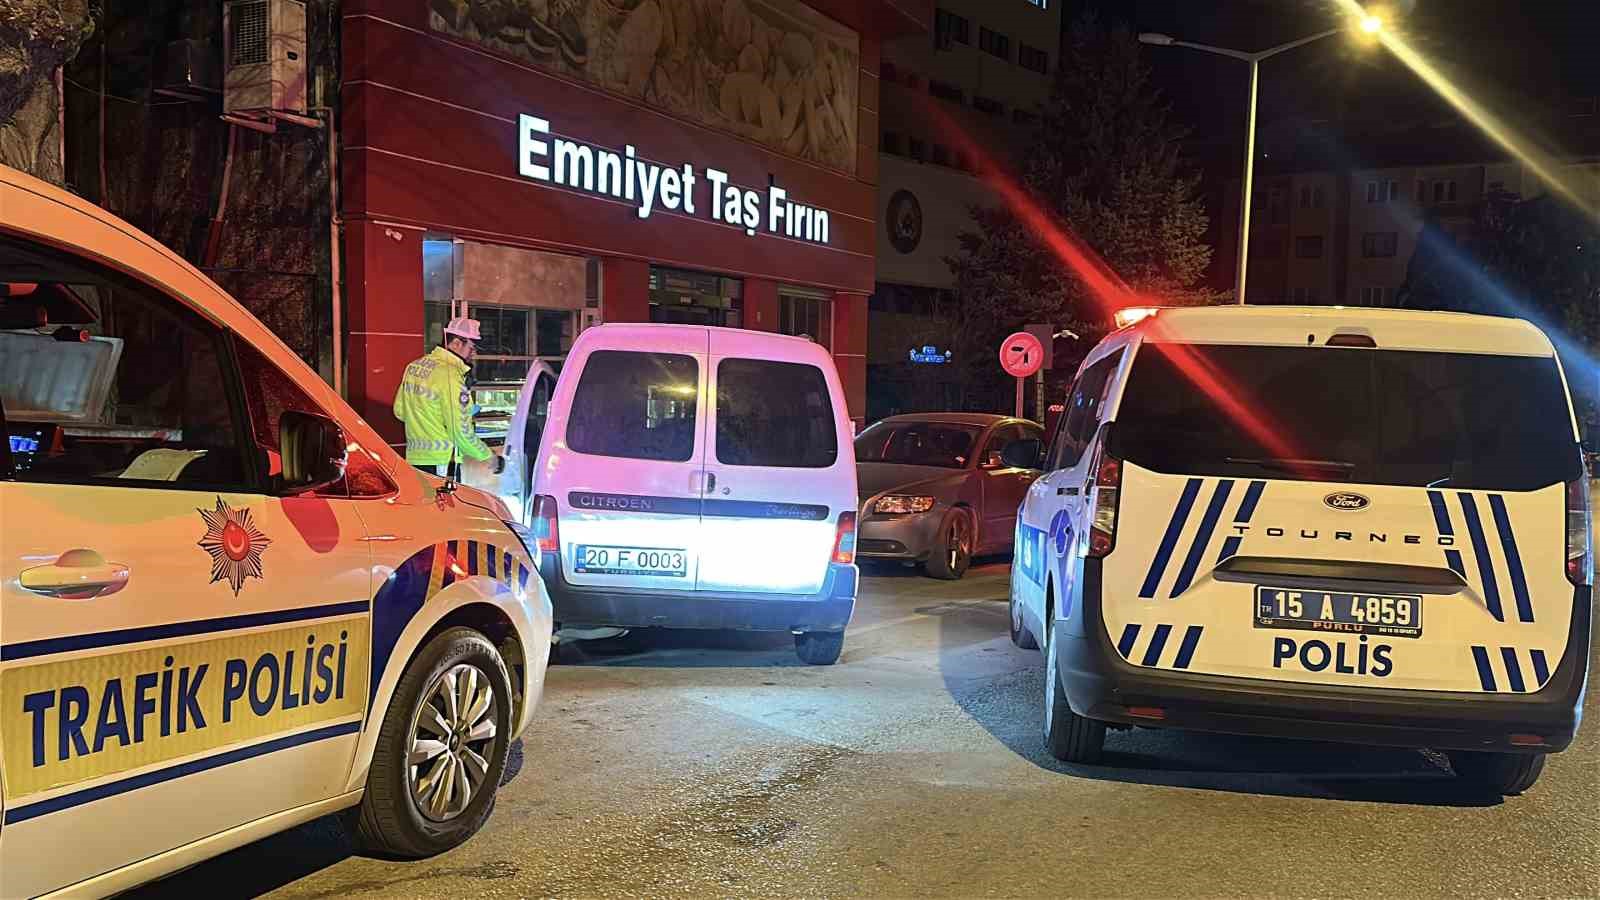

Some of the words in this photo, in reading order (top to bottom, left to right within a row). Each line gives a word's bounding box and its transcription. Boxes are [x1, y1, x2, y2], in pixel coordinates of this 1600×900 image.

[518, 113, 696, 220] Emniyet
[706, 168, 761, 236] Taş
[768, 186, 830, 243] Fırın
[1332, 495, 1362, 508] Ford
[1233, 525, 1455, 546] TOURNEO
[586, 549, 609, 566] 20
[617, 550, 631, 568] F
[637, 552, 682, 569] 0003
[1275, 591, 1303, 618] 15
[1320, 594, 1335, 621] A
[1351, 596, 1411, 626] 4859
[1273, 634, 1393, 677] POLİS
[23, 655, 209, 768] TRAFİK
[222, 630, 348, 723] POLİSİ
